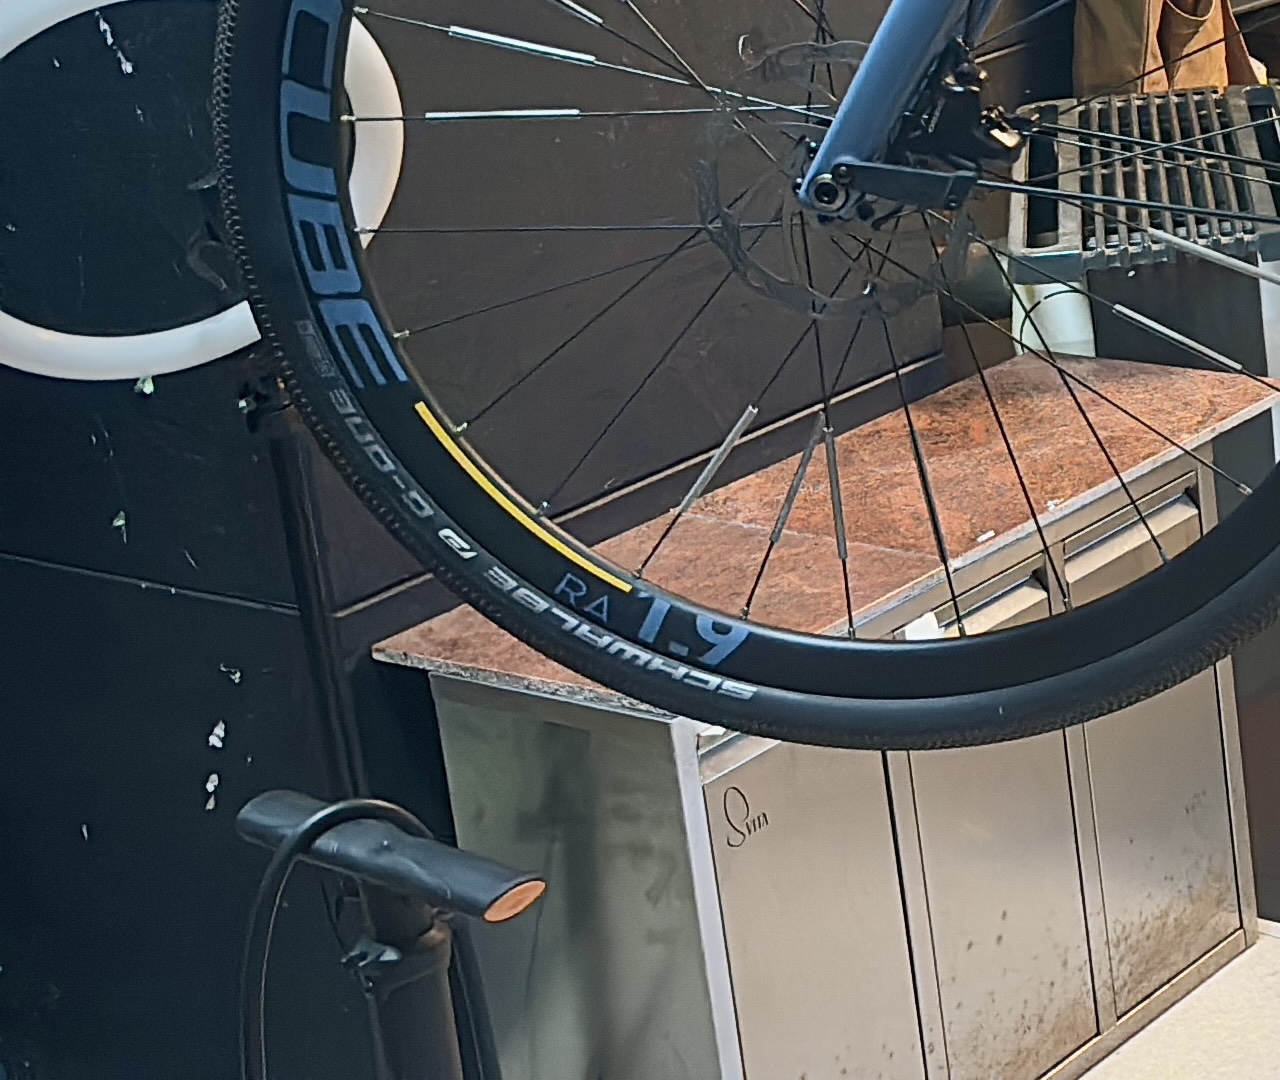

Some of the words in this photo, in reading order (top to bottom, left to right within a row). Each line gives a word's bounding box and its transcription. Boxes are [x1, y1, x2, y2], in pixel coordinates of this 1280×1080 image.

[484, 565, 759, 700] SCHWALBE
[554, 572, 609, 624] RA
[638, 589, 750, 668] 1.9
